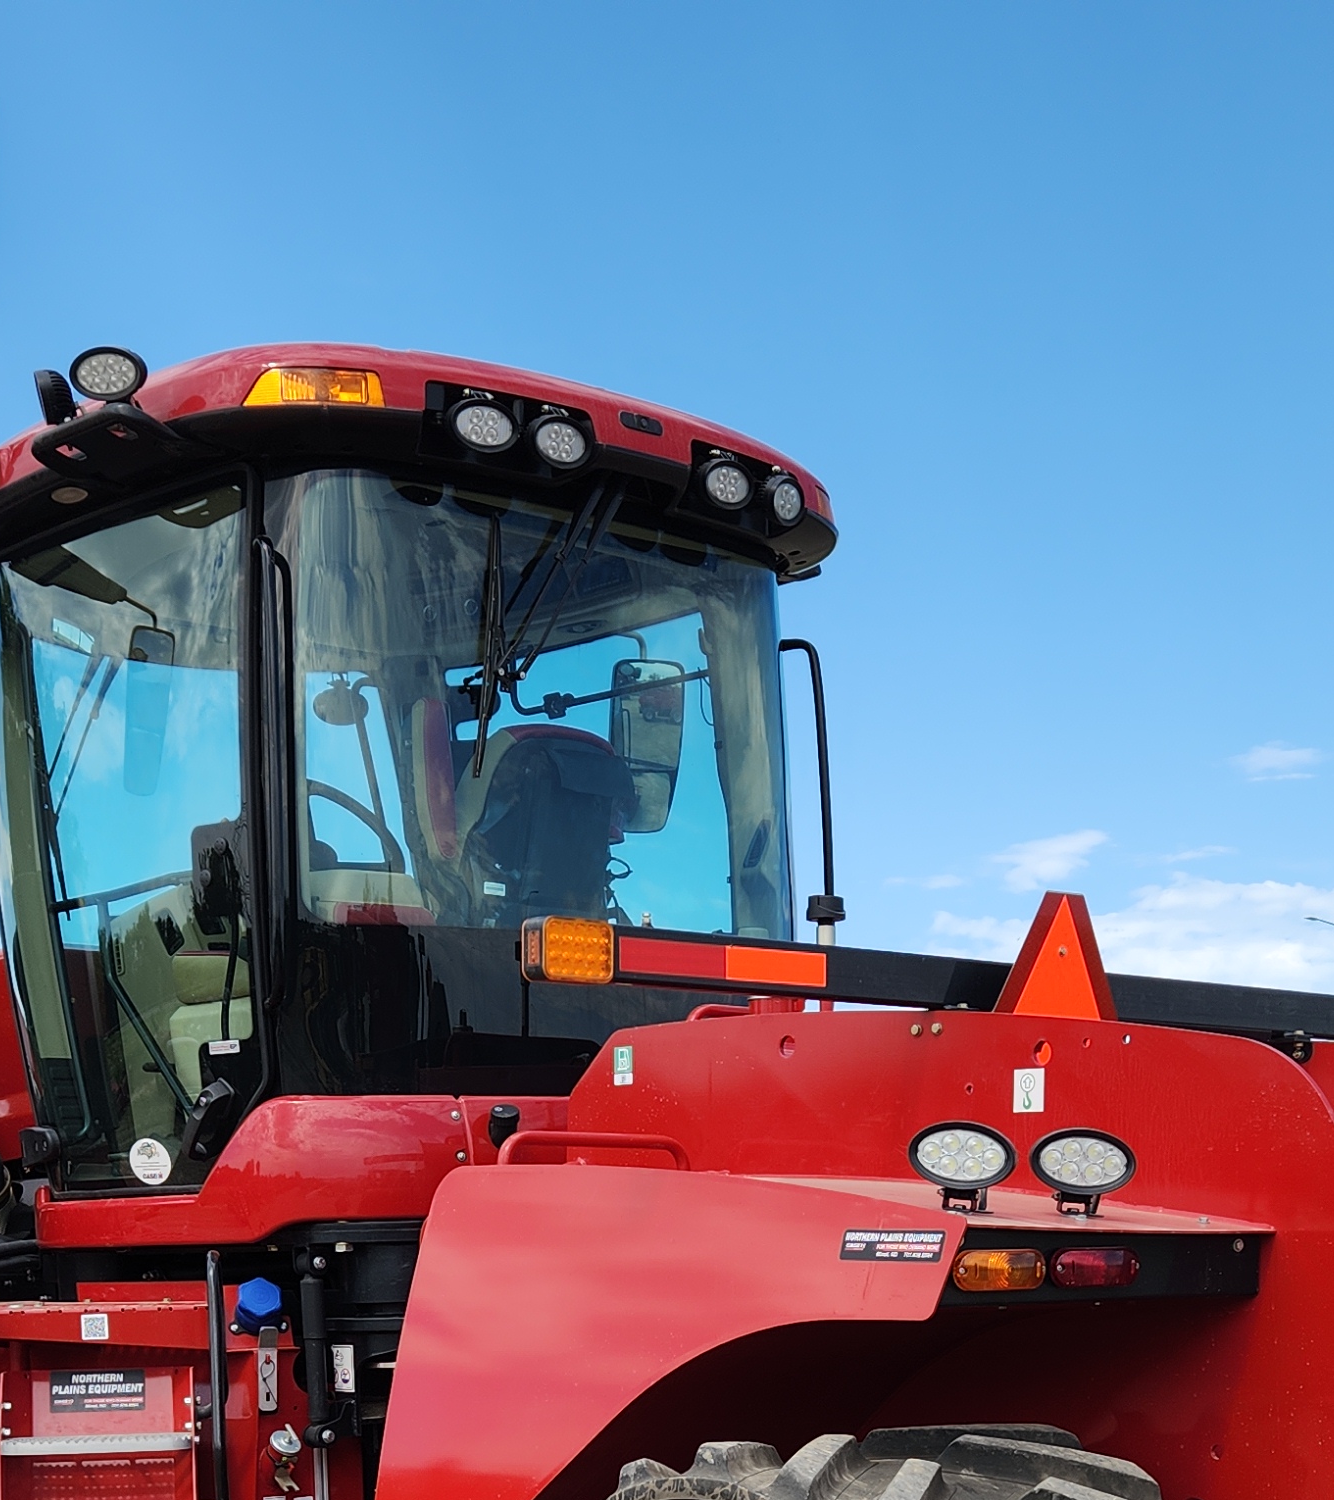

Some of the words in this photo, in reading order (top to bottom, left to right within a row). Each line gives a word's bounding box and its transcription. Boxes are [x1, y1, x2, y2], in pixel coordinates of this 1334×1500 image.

[845, 1231, 880, 1241] NORTHERN
[880, 1232, 903, 1242] PLAINS
[903, 1233, 943, 1243] EQUIPMENT
[71, 1373, 124, 1384] NORTHERN
[52, 1385, 86, 1395] PLAINS
[88, 1383, 144, 1394] EQUIPMENT
